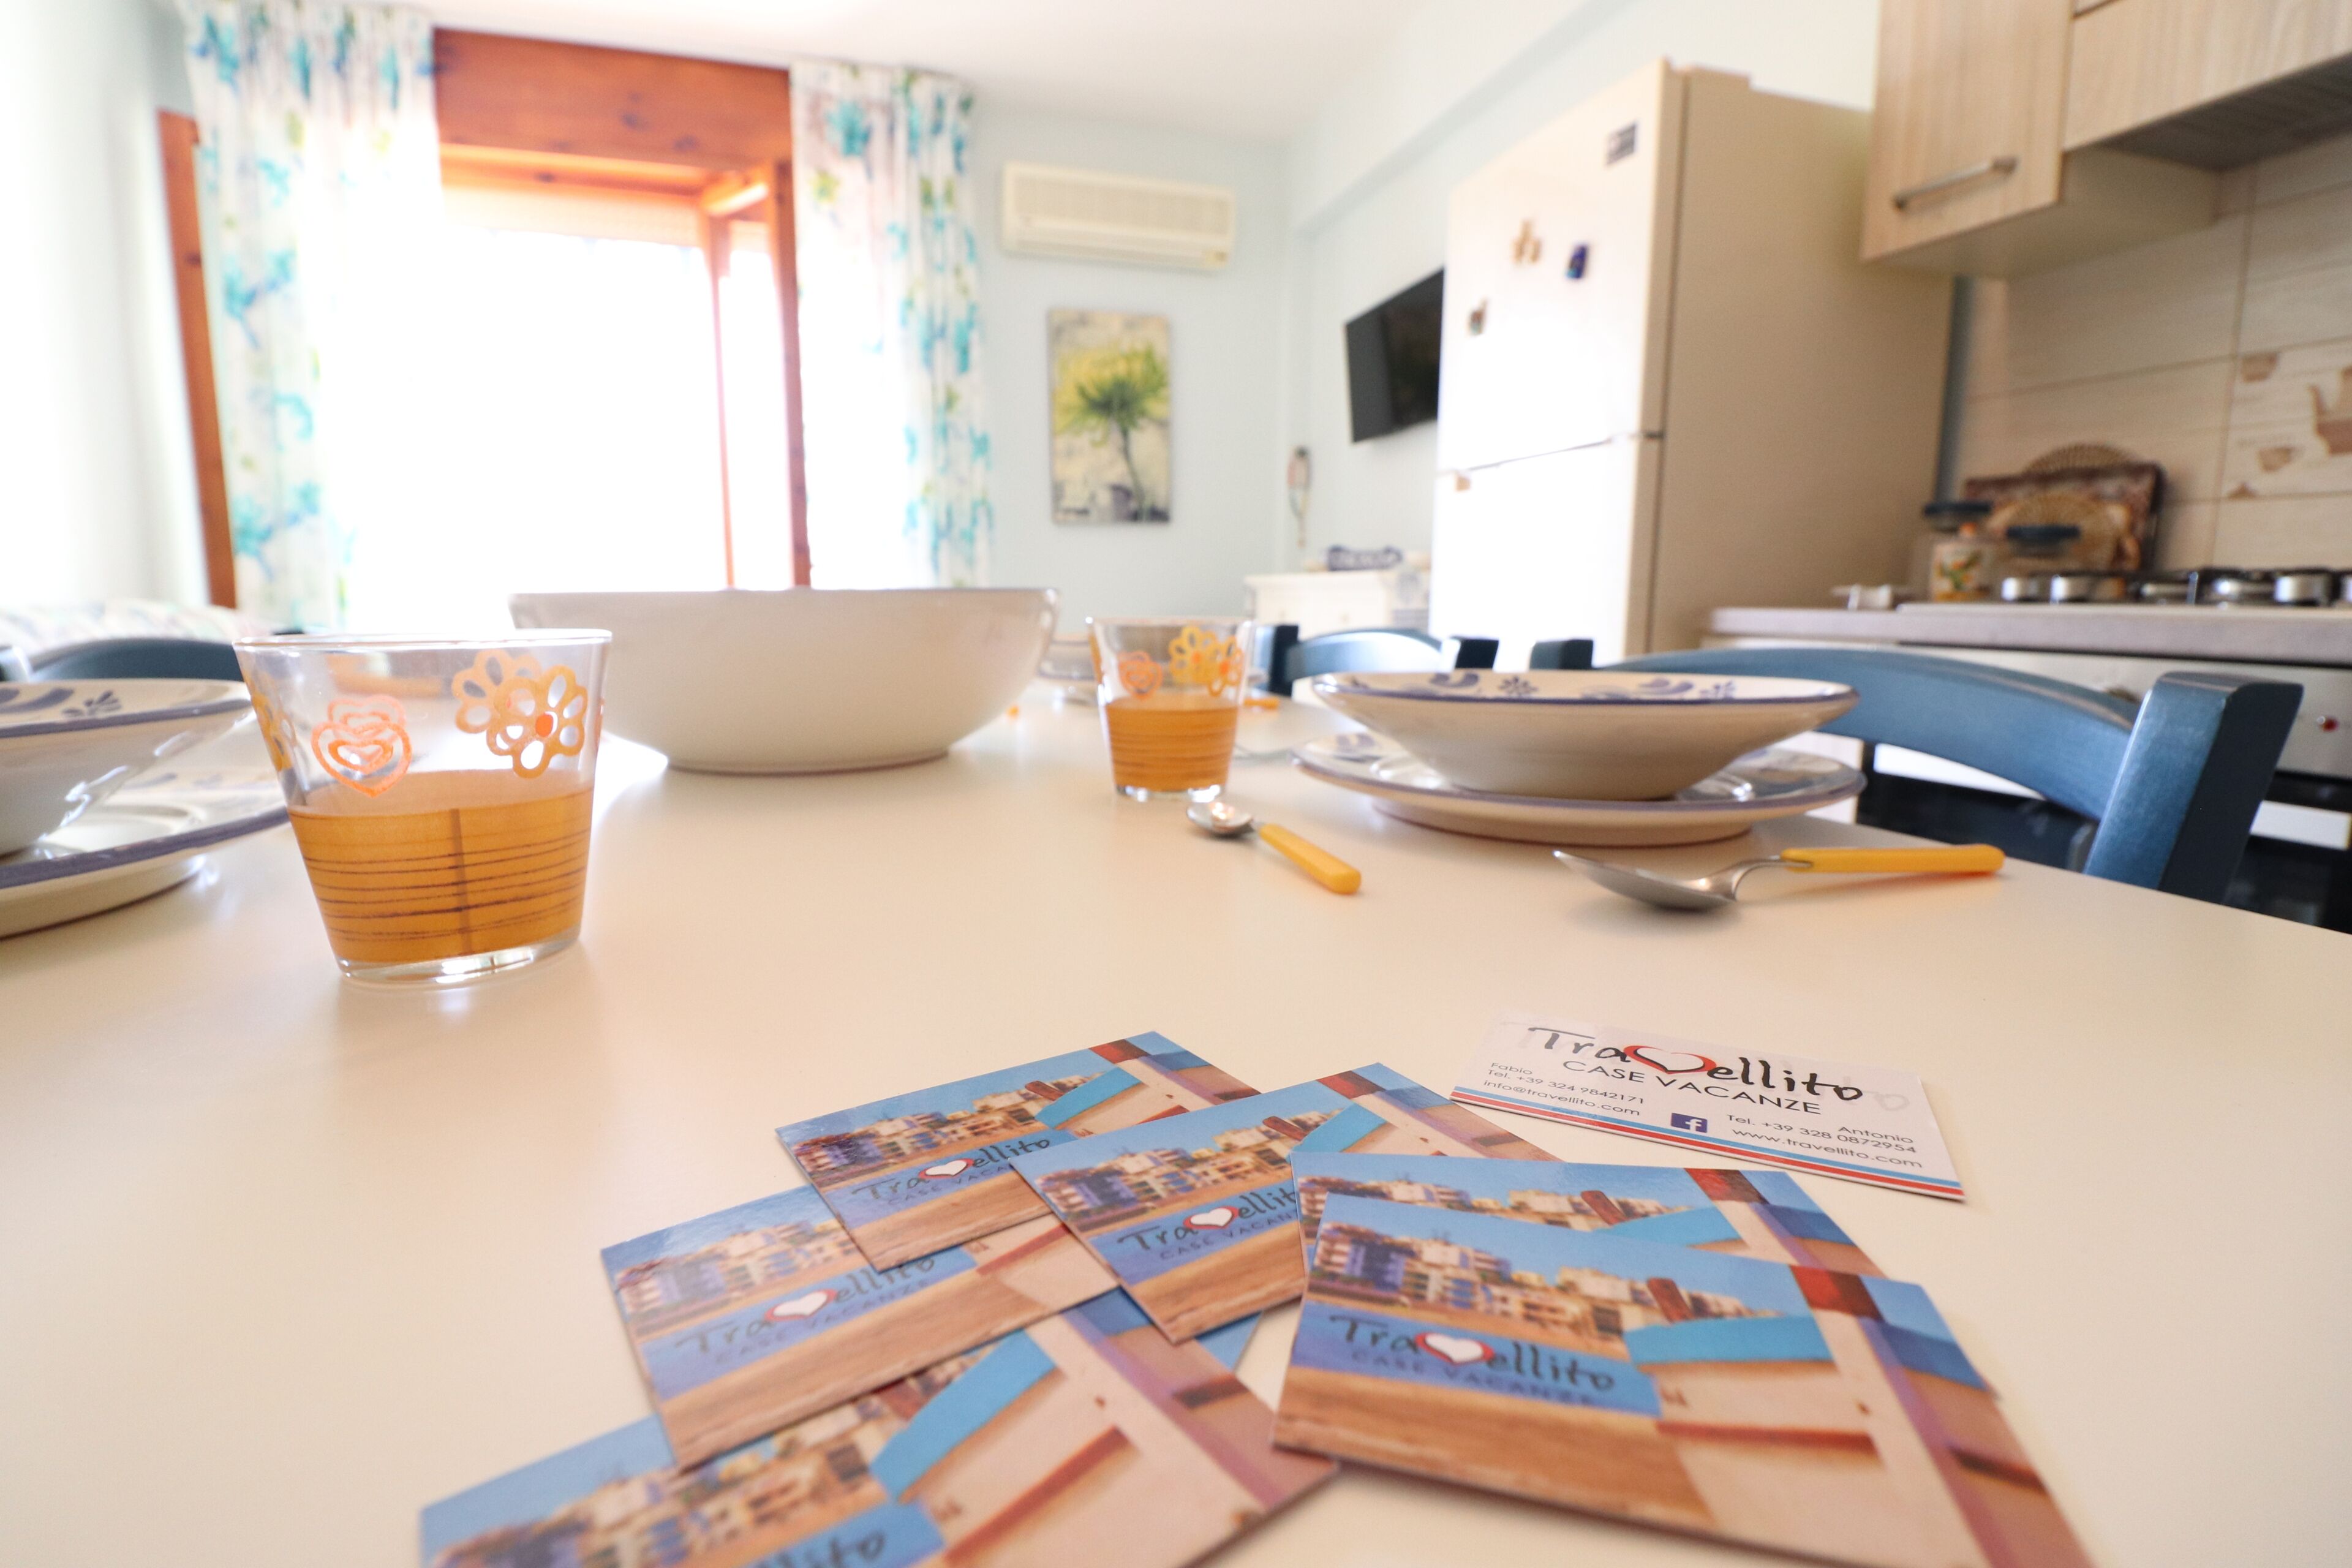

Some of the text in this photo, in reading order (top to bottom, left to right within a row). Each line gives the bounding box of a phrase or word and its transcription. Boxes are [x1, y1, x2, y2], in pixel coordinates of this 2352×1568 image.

[1487, 1069, 1644, 1104] Tel. +39 324 9842171
[1490, 1062, 1533, 1076] Fabio
[1562, 1060, 1822, 1115] CASE VACANZE
[1483, 1079, 1641, 1117] info@travellito.com
[1727, 1114, 1917, 1154] Tel. +39 328 0872954
[1732, 1128, 1923, 1169] www.travellito.com
[1838, 1126, 1913, 1144] Antonio
[1117, 1187, 1297, 1250] Travellit
[1223, 1210, 1295, 1239] VACAN
